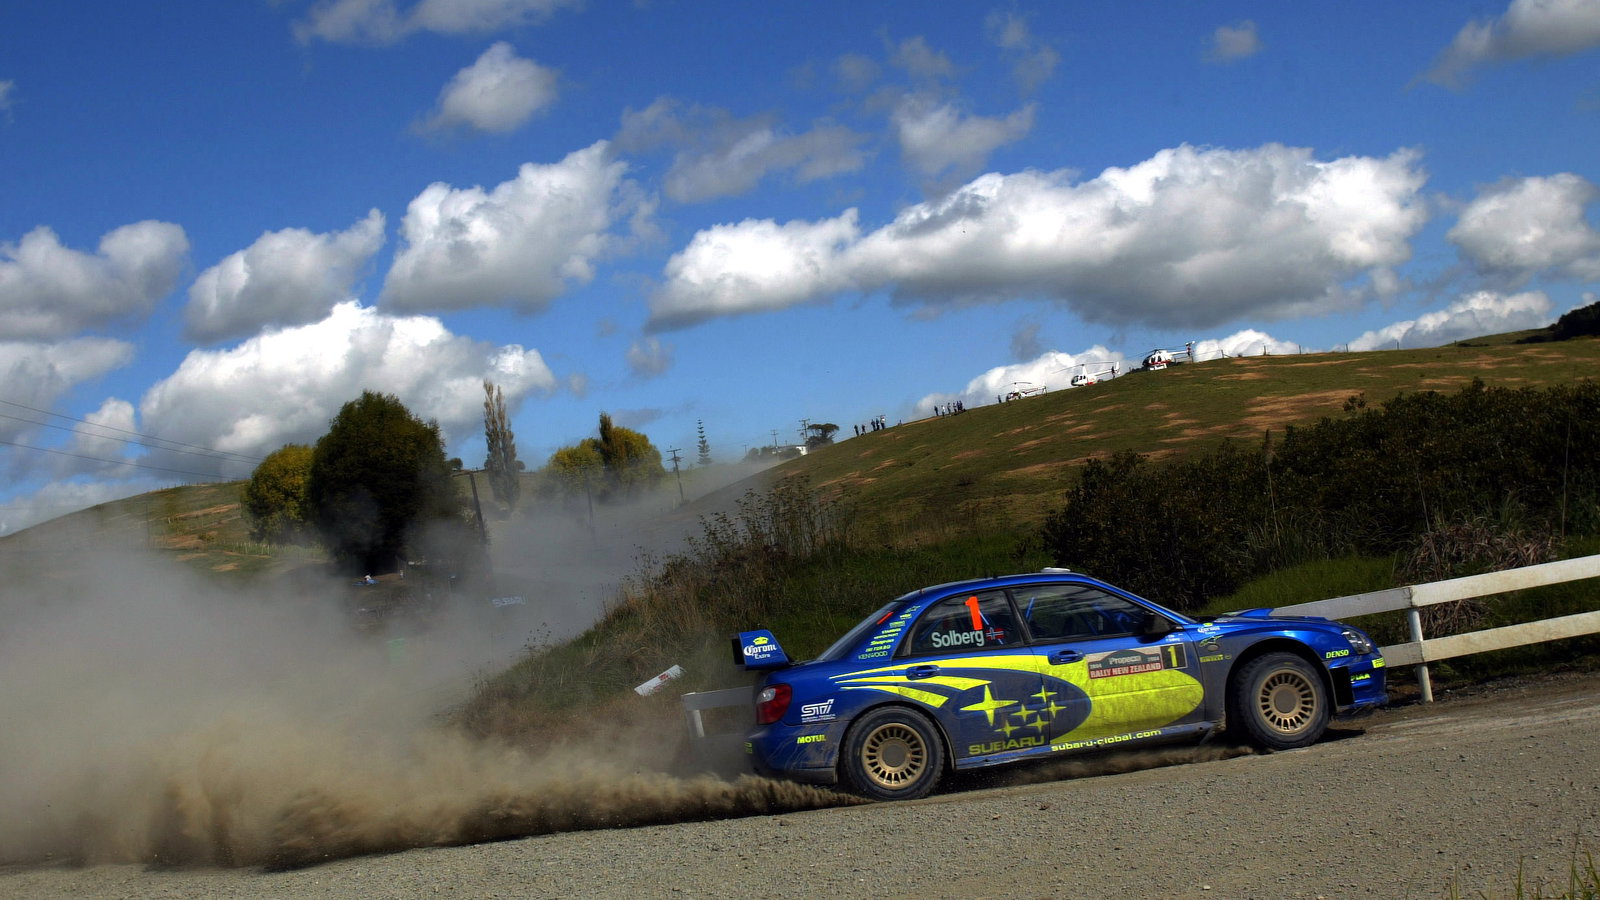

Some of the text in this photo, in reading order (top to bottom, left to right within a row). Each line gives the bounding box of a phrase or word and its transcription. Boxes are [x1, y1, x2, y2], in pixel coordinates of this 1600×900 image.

[965, 596, 983, 631] 1
[931, 630, 985, 648] Solberg
[743, 644, 777, 656] Corona
[858, 651, 888, 660] KENWOOD
[1168, 646, 1178, 667] 1
[1326, 649, 1349, 659] DENSO
[1090, 662, 1161, 678] RALLY NEW ZEALAND
[797, 735, 826, 744] MOTUL
[969, 736, 1045, 755] SUBARU
